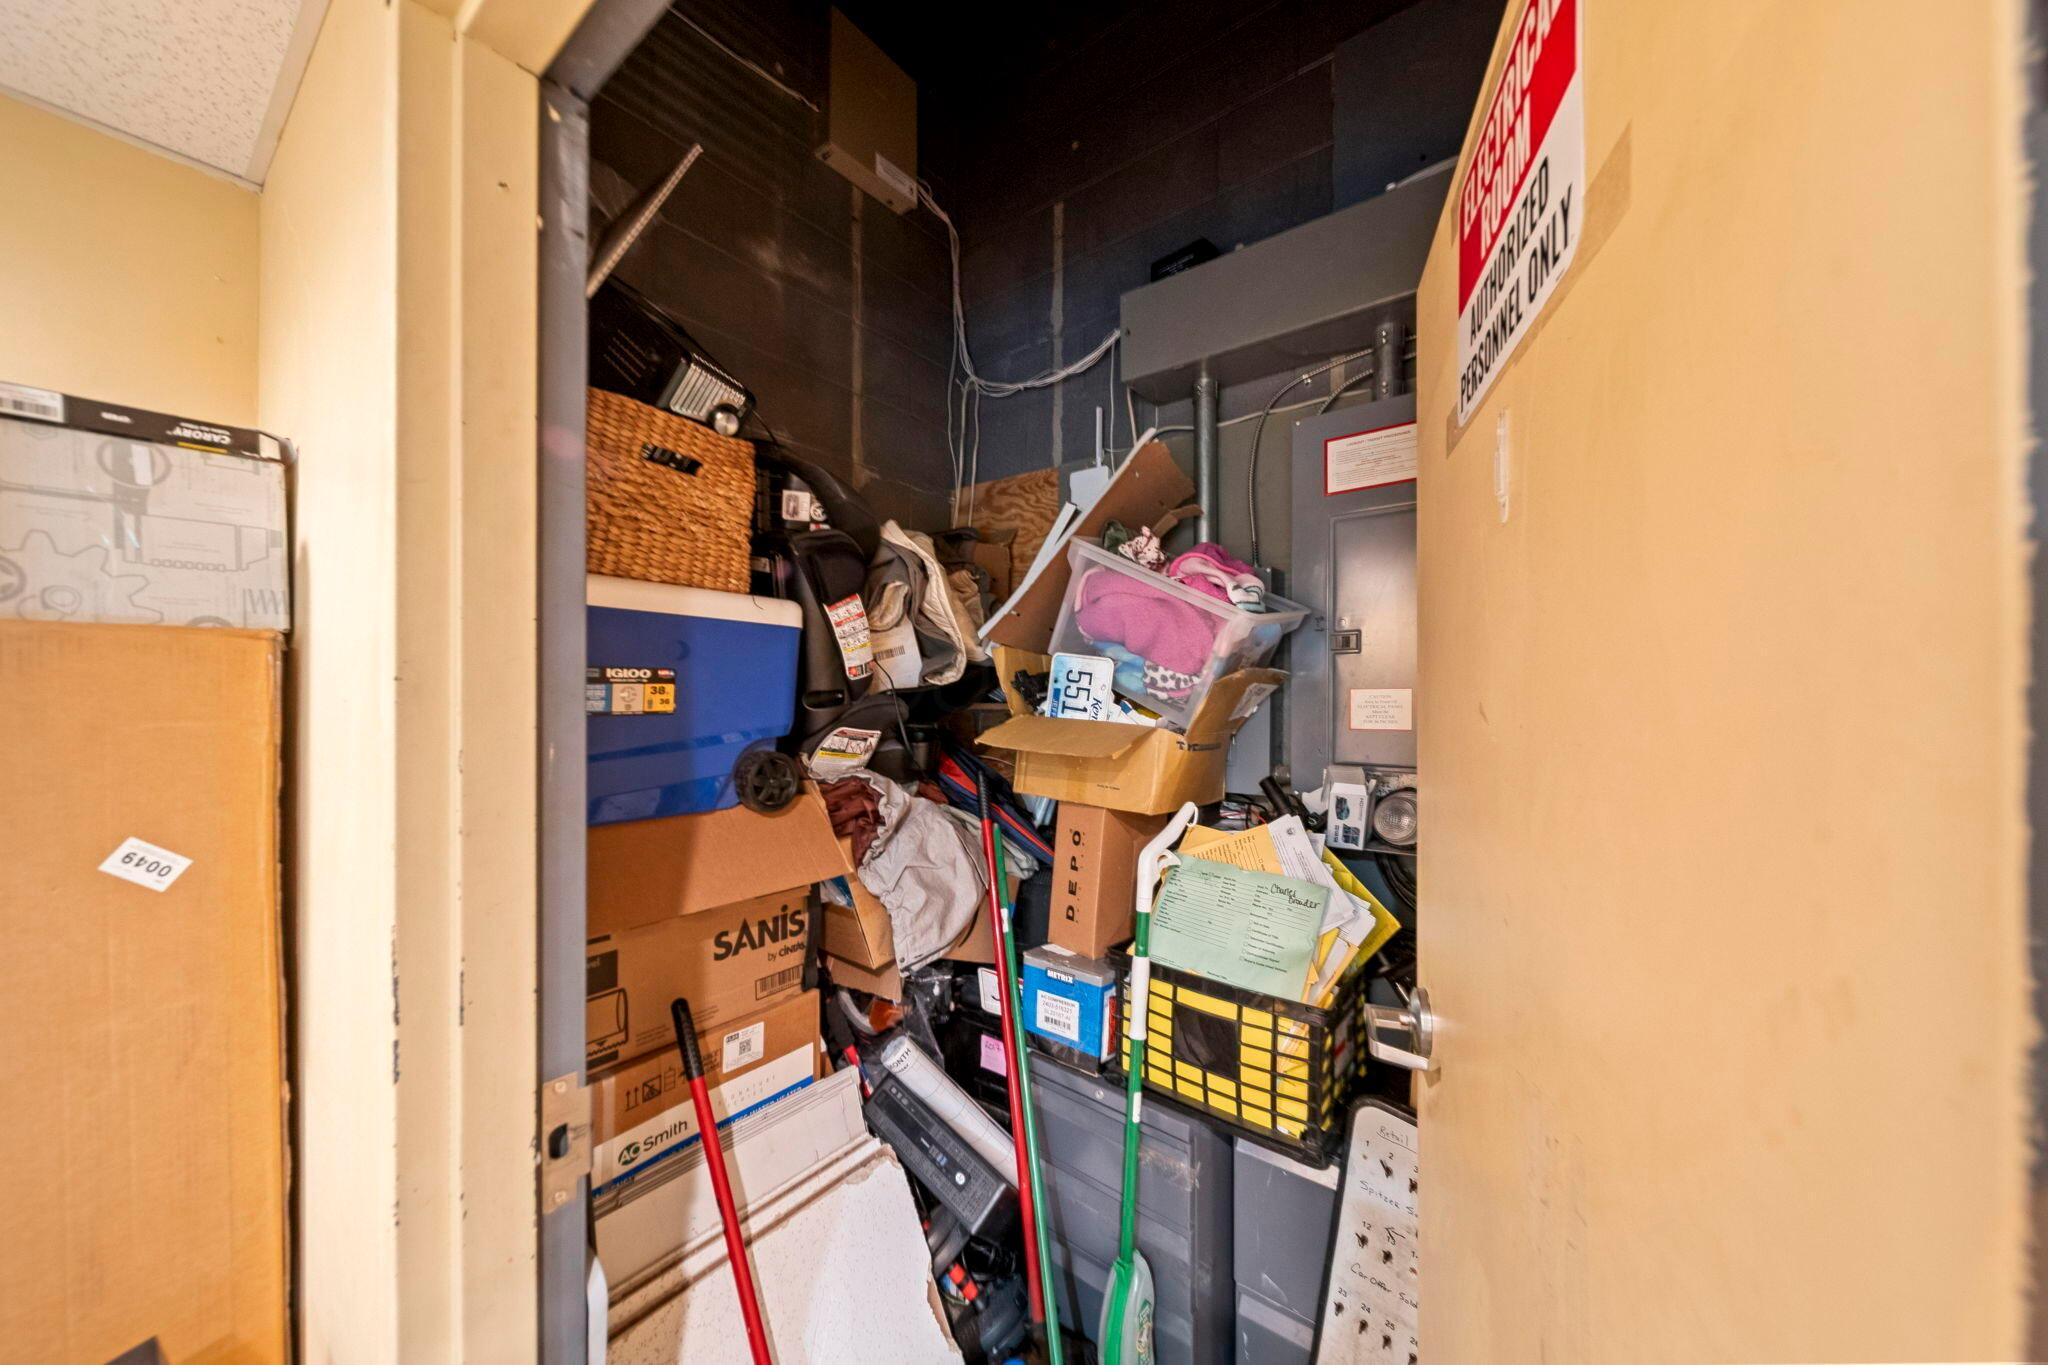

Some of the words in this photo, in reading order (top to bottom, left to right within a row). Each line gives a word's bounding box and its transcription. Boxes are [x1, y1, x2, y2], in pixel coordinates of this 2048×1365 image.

[1464, 0, 1562, 241] ELECTRICA
[1480, 90, 1531, 261] ROOM
[1470, 155, 1549, 347] AUTHORIZED
[1460, 276, 1523, 414] PERSONNEL
[1528, 182, 1573, 304] ONLY
[606, 668, 652, 679] IGLOO
[650, 686, 666, 695] 38
[1061, 669, 1093, 714] 551
[1091, 697, 1103, 720] Ken
[121, 851, 172, 877] 0049
[1066, 830, 1082, 922] DEPO
[768, 952, 778, 962] by
[1047, 969, 1073, 984] METRIX
[643, 1120, 688, 1152] Smith
[1380, 1126, 1408, 1147] Retail
[1388, 1152, 1394, 1160] 2
[1362, 1221, 1372, 1231] 12
[1361, 1302, 1371, 1313] 24
[1385, 1320, 1395, 1331] 25
